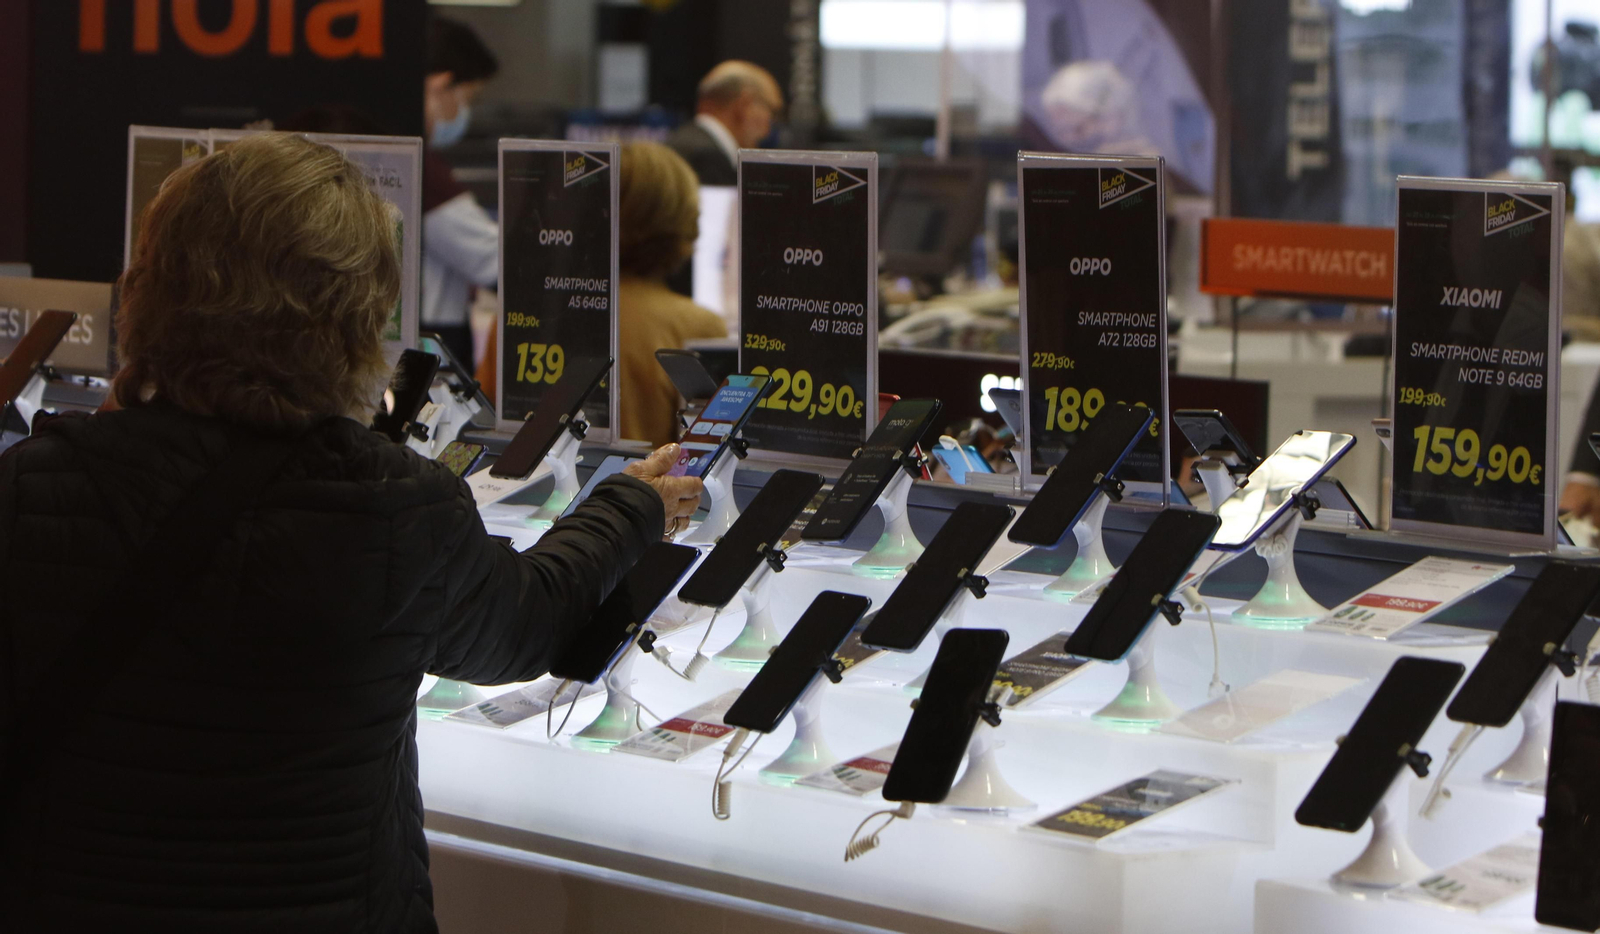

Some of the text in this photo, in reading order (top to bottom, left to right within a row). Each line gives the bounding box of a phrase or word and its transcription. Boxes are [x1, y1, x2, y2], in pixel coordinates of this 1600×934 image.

[815, 171, 840, 188] BLACK
[1101, 173, 1126, 191] BLACK
[815, 181, 840, 198] FRIDAY
[1101, 183, 1127, 202] FRIDAY
[1488, 198, 1516, 218] BLACK
[1488, 210, 1516, 229] FRIDAY
[539, 229, 574, 246] OPPO
[1508, 221, 1535, 239] TOTAL
[783, 247, 824, 266] OPPO
[1232, 243, 1388, 278] SMARTWATCH
[1069, 257, 1112, 276] OPPO
[543, 276, 609, 292] SMARTPHONE
[568, 296, 608, 310] A5 64GB
[756, 295, 864, 317] SMARTPHONE OPPO
[1440, 286, 1503, 309] XIAOMI
[810, 318, 864, 336] A91 128GB
[1077, 311, 1157, 328] SMARTPHONE
[1097, 332, 1157, 348] A72 128GB
[1410, 342, 1545, 367] SMARTPHONE REDMI
[1458, 367, 1543, 389] NOTE 9 64GB
[1412, 424, 1542, 487] 159,90€
